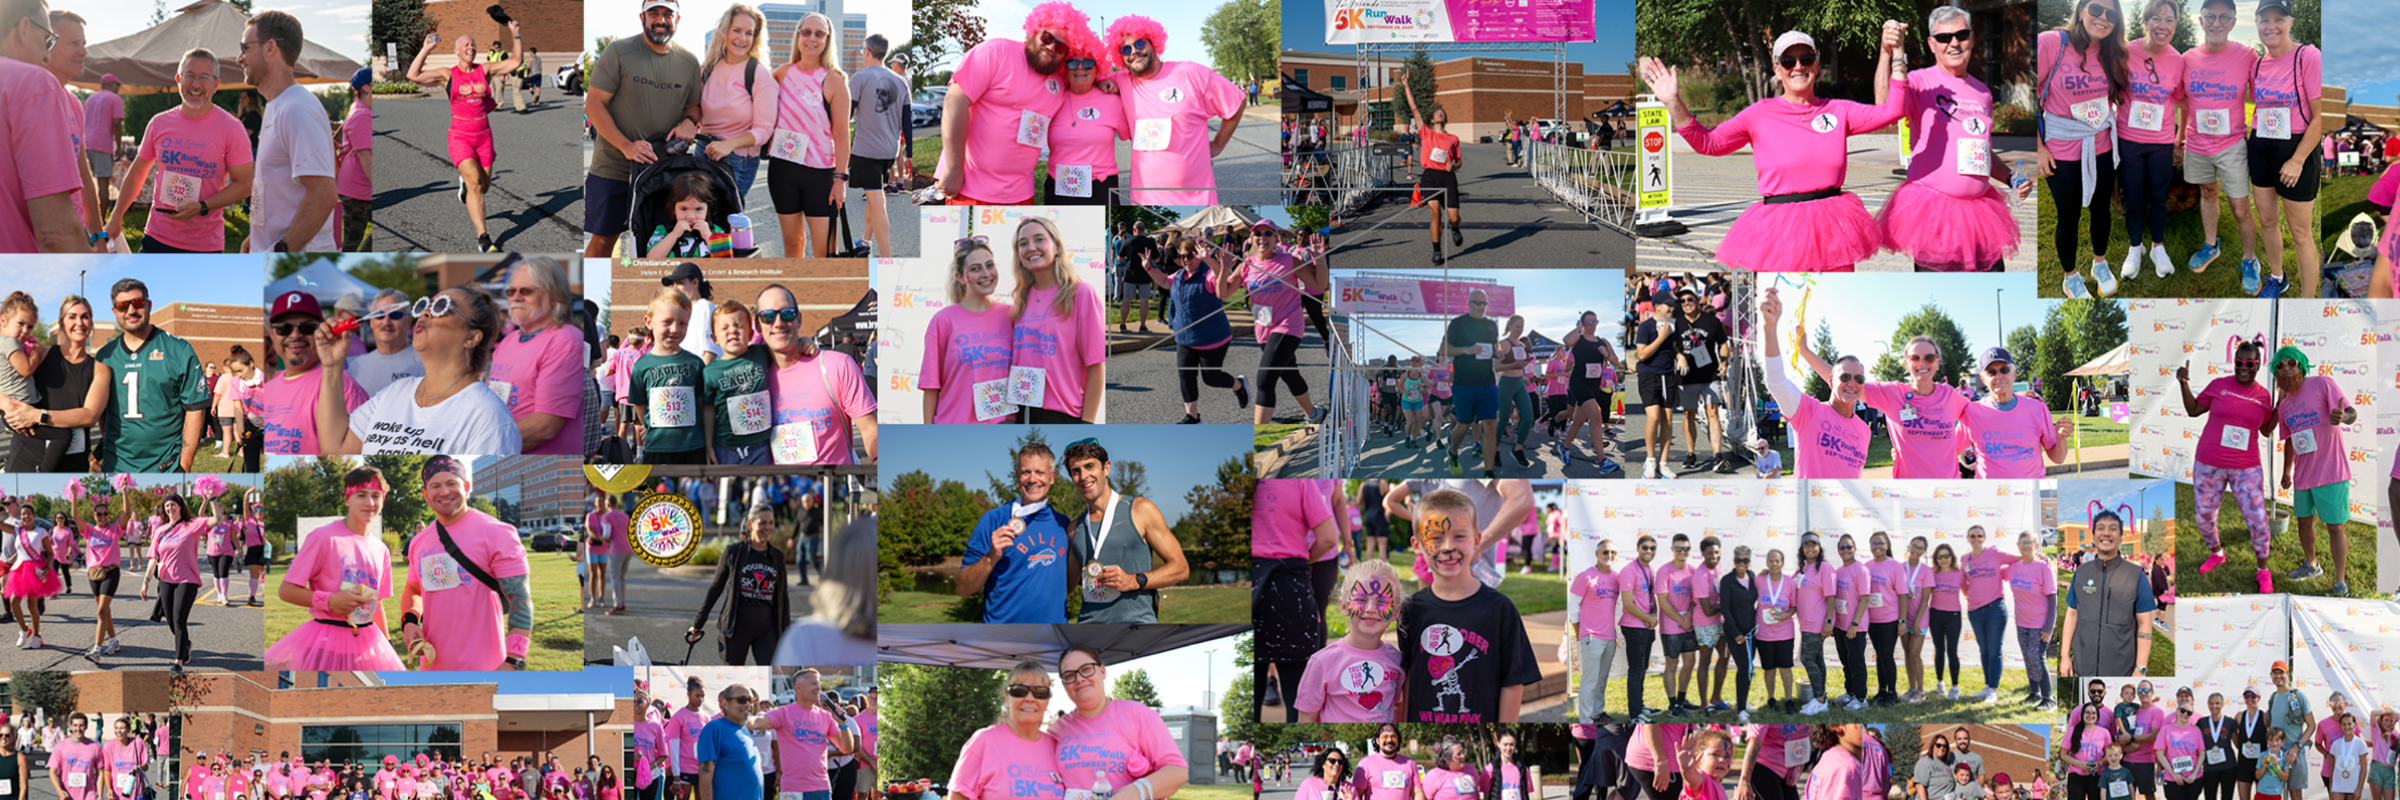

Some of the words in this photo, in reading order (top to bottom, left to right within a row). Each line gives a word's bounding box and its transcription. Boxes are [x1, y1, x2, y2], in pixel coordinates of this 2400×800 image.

[1335, 8, 1366, 30] 5K
[1365, 8, 1386, 18] Run
[1384, 15, 1412, 25] Walk
[633, 75, 673, 90] GORUCK
[2064, 75, 2090, 91] 5K
[2131, 82, 2149, 94] 5K
[2190, 81, 2207, 93] 5K
[1643, 110, 1663, 118] STATE
[1645, 137, 1663, 148] STOP
[161, 150, 183, 166] 5K
[181, 154, 198, 164] Run
[197, 160, 218, 171] Walk
[202, 170, 216, 181] 28
[929, 213, 948, 224] Walk
[981, 209, 1006, 225] 5K
[1006, 210, 1022, 221] Run
[632, 259, 681, 269] ChristianaCare
[1074, 256, 1091, 266] Run
[893, 293, 914, 308] 5K
[1341, 288, 1366, 303] 5K
[1364, 288, 1380, 296] Run
[1377, 292, 1398, 301] Walk
[925, 300, 944, 308] Walk
[2322, 305, 2340, 318] 5K
[2281, 337, 2296, 348] 5K
[2360, 332, 2377, 346] 5K
[962, 344, 986, 363] 5K
[1041, 343, 1057, 356] 28
[650, 363, 691, 383] EAGLES
[2318, 364, 2334, 376] 5K
[718, 366, 763, 392] EAGLES
[890, 376, 912, 392] 5K
[121, 370, 145, 421] 1
[2355, 394, 2372, 405] 5K
[666, 401, 682, 412] 513
[746, 406, 762, 420] 514
[805, 407, 832, 420] Walk
[373, 422, 403, 433] woke
[814, 418, 833, 432] 28
[2376, 427, 2395, 436] Walk
[277, 426, 303, 439] Walk
[405, 427, 425, 438] up
[280, 440, 301, 454] 28
[393, 435, 409, 446] as
[410, 436, 445, 452] hell
[783, 439, 798, 450] 512
[1820, 432, 1842, 453] 5K
[1984, 442, 2005, 455] 5K
[2350, 451, 2367, 462] 5K
[650, 513, 674, 532] 5K
[1016, 532, 1066, 557] BILLS
[742, 563, 777, 578] POURING
[741, 577, 755, 588] 5K
[1429, 633, 1440, 641] FOR
[1429, 640, 1439, 649] HP
[1348, 664, 1363, 674] TROT
[1352, 678, 1363, 689] HP
[1419, 711, 1433, 722] WE
[1434, 712, 1459, 724] WEAR
[1059, 744, 1082, 762] 5K
[1080, 744, 1101, 754] Run
[1098, 749, 1127, 761] Walk
[1063, 760, 1107, 770] SEPTEMBER
[1107, 761, 1126, 775] 28
[1014, 779, 1040, 798] 5K
[1036, 782, 1056, 794] Run
